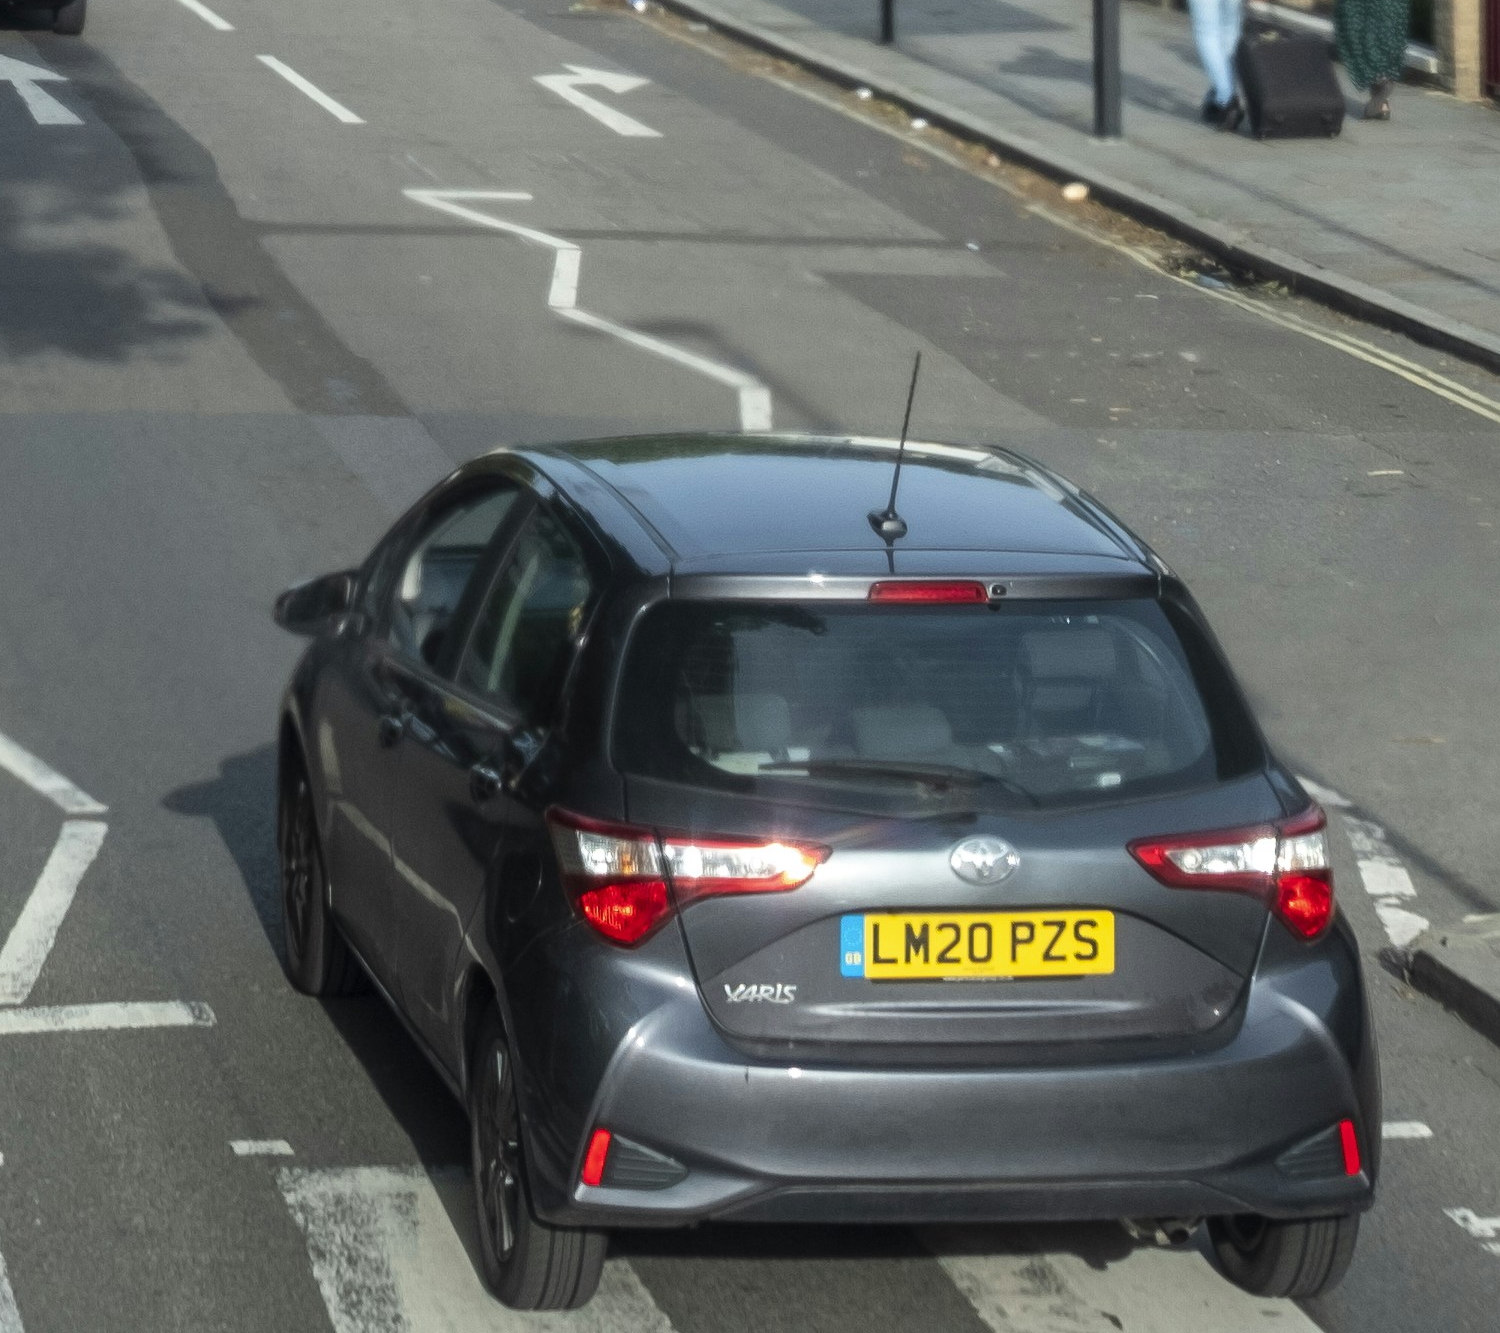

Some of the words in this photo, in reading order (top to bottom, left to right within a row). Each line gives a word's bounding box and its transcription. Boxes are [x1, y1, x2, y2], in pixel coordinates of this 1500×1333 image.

[872, 922, 993, 965] LM20
[1010, 919, 1099, 963] PZS
[723, 983, 797, 1005] YARIS
